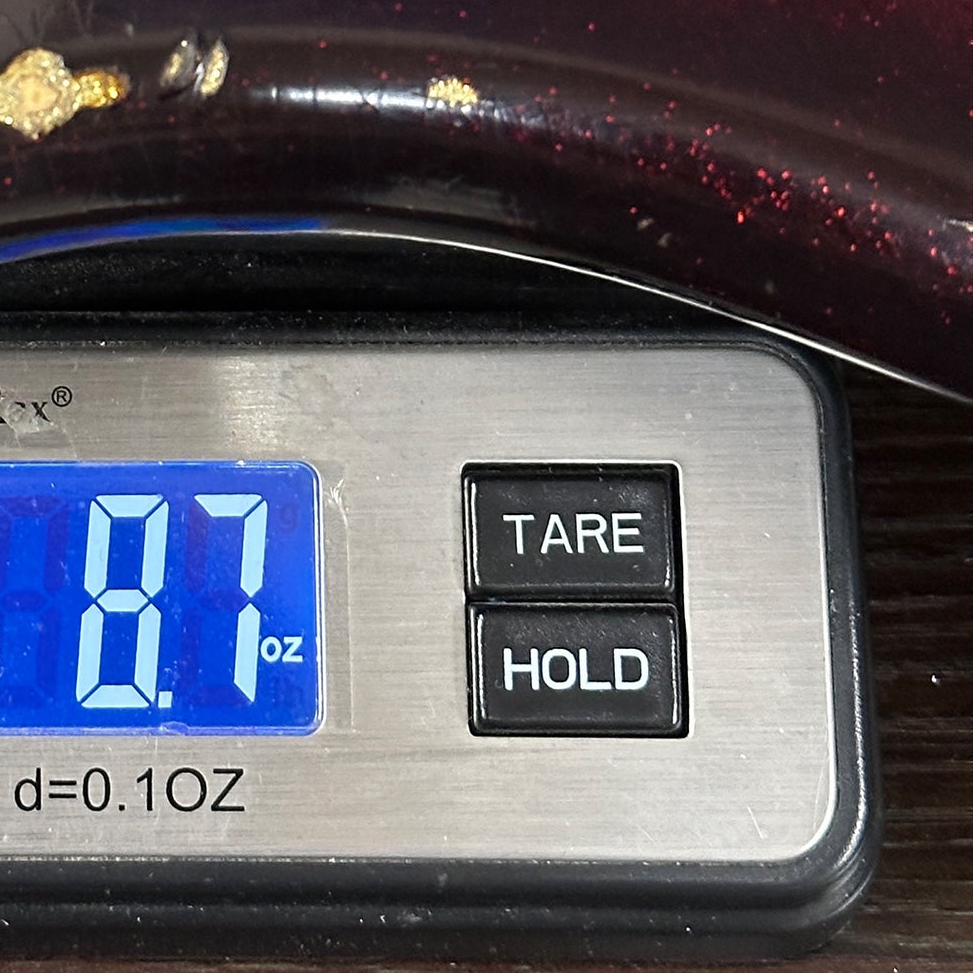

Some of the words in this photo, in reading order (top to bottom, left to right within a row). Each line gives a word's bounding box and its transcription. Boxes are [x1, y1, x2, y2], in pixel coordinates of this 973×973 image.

[502, 512, 645, 555] TARE
[75, 493, 269, 709] 8.7
[259, 635, 304, 664] oz
[502, 647, 650, 691] HOLD
[13, 767, 246, 812] d=0.1OZ
